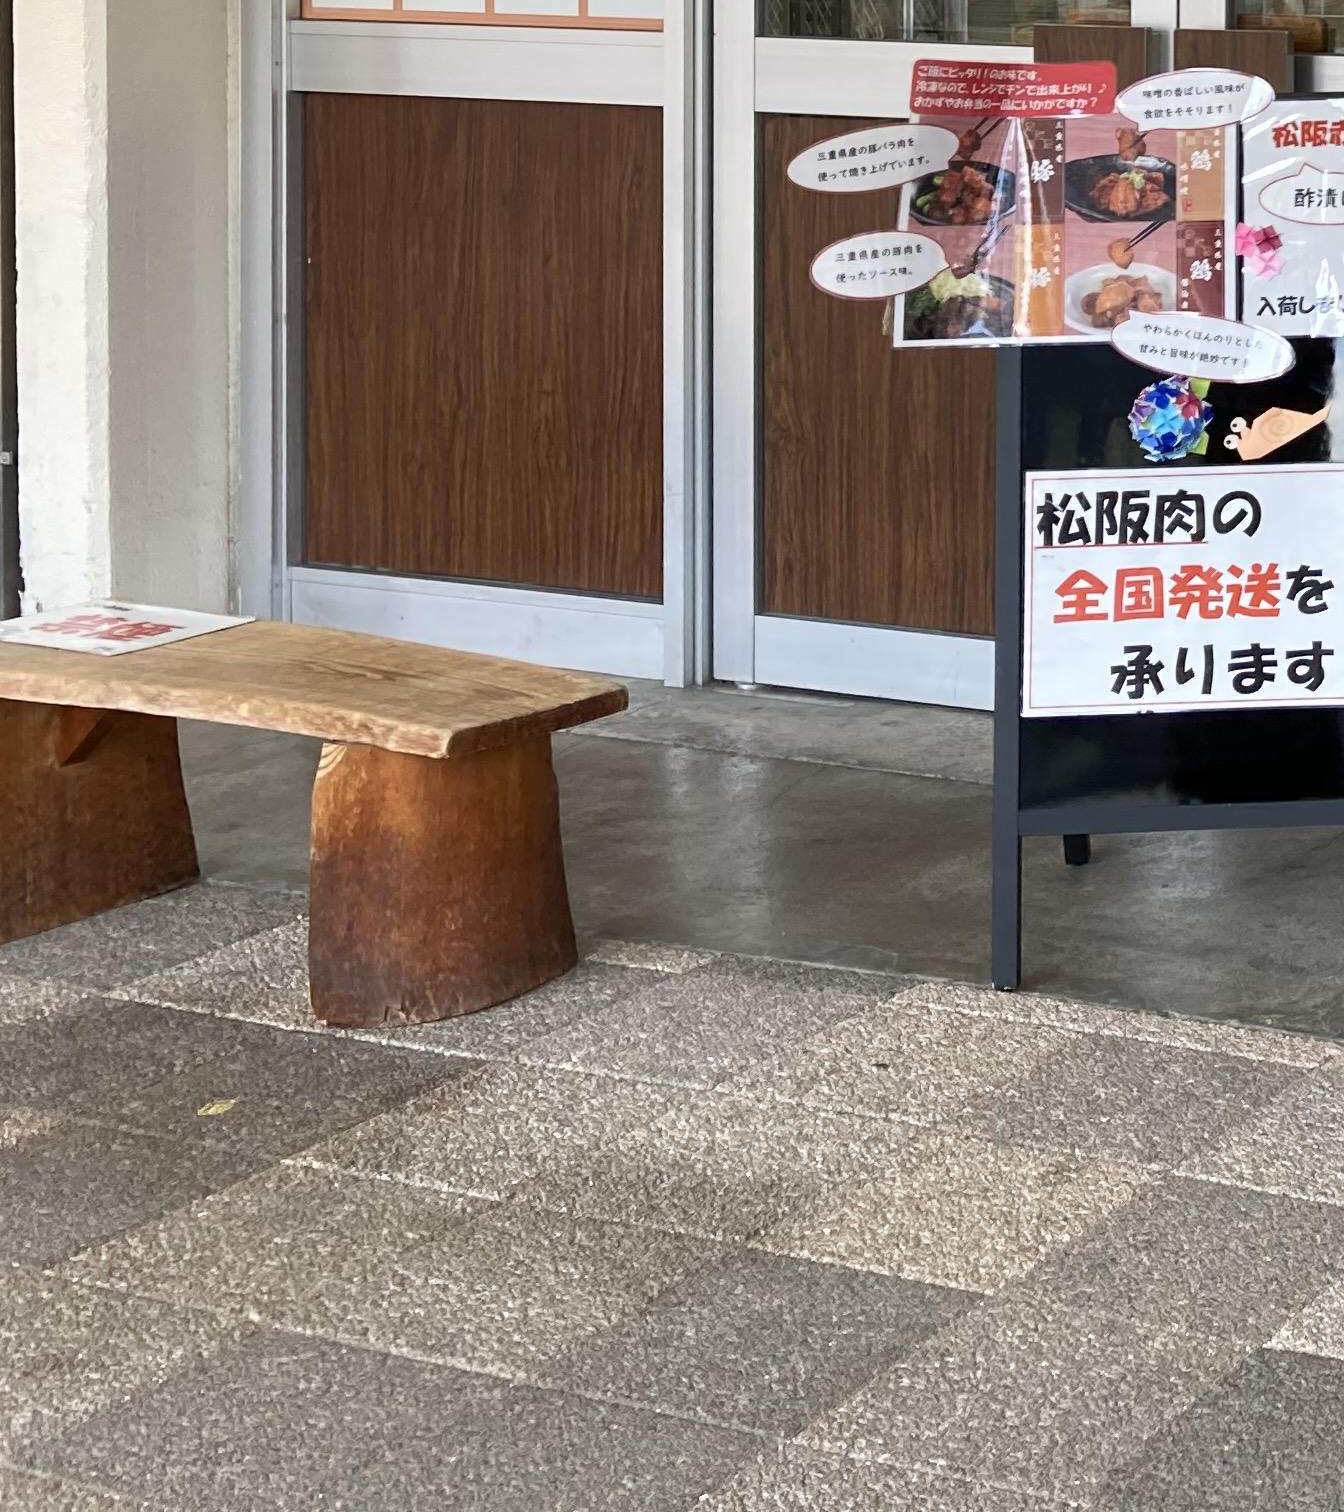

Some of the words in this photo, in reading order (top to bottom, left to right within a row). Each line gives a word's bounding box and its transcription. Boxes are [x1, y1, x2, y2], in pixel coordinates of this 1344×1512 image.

[834, 243, 924, 262] 三重県産の豚肉を
[1036, 488, 1262, 547] 松阪肉の
[1053, 562, 1335, 624] 全国発送を
[1110, 640, 1335, 700] 承ります
